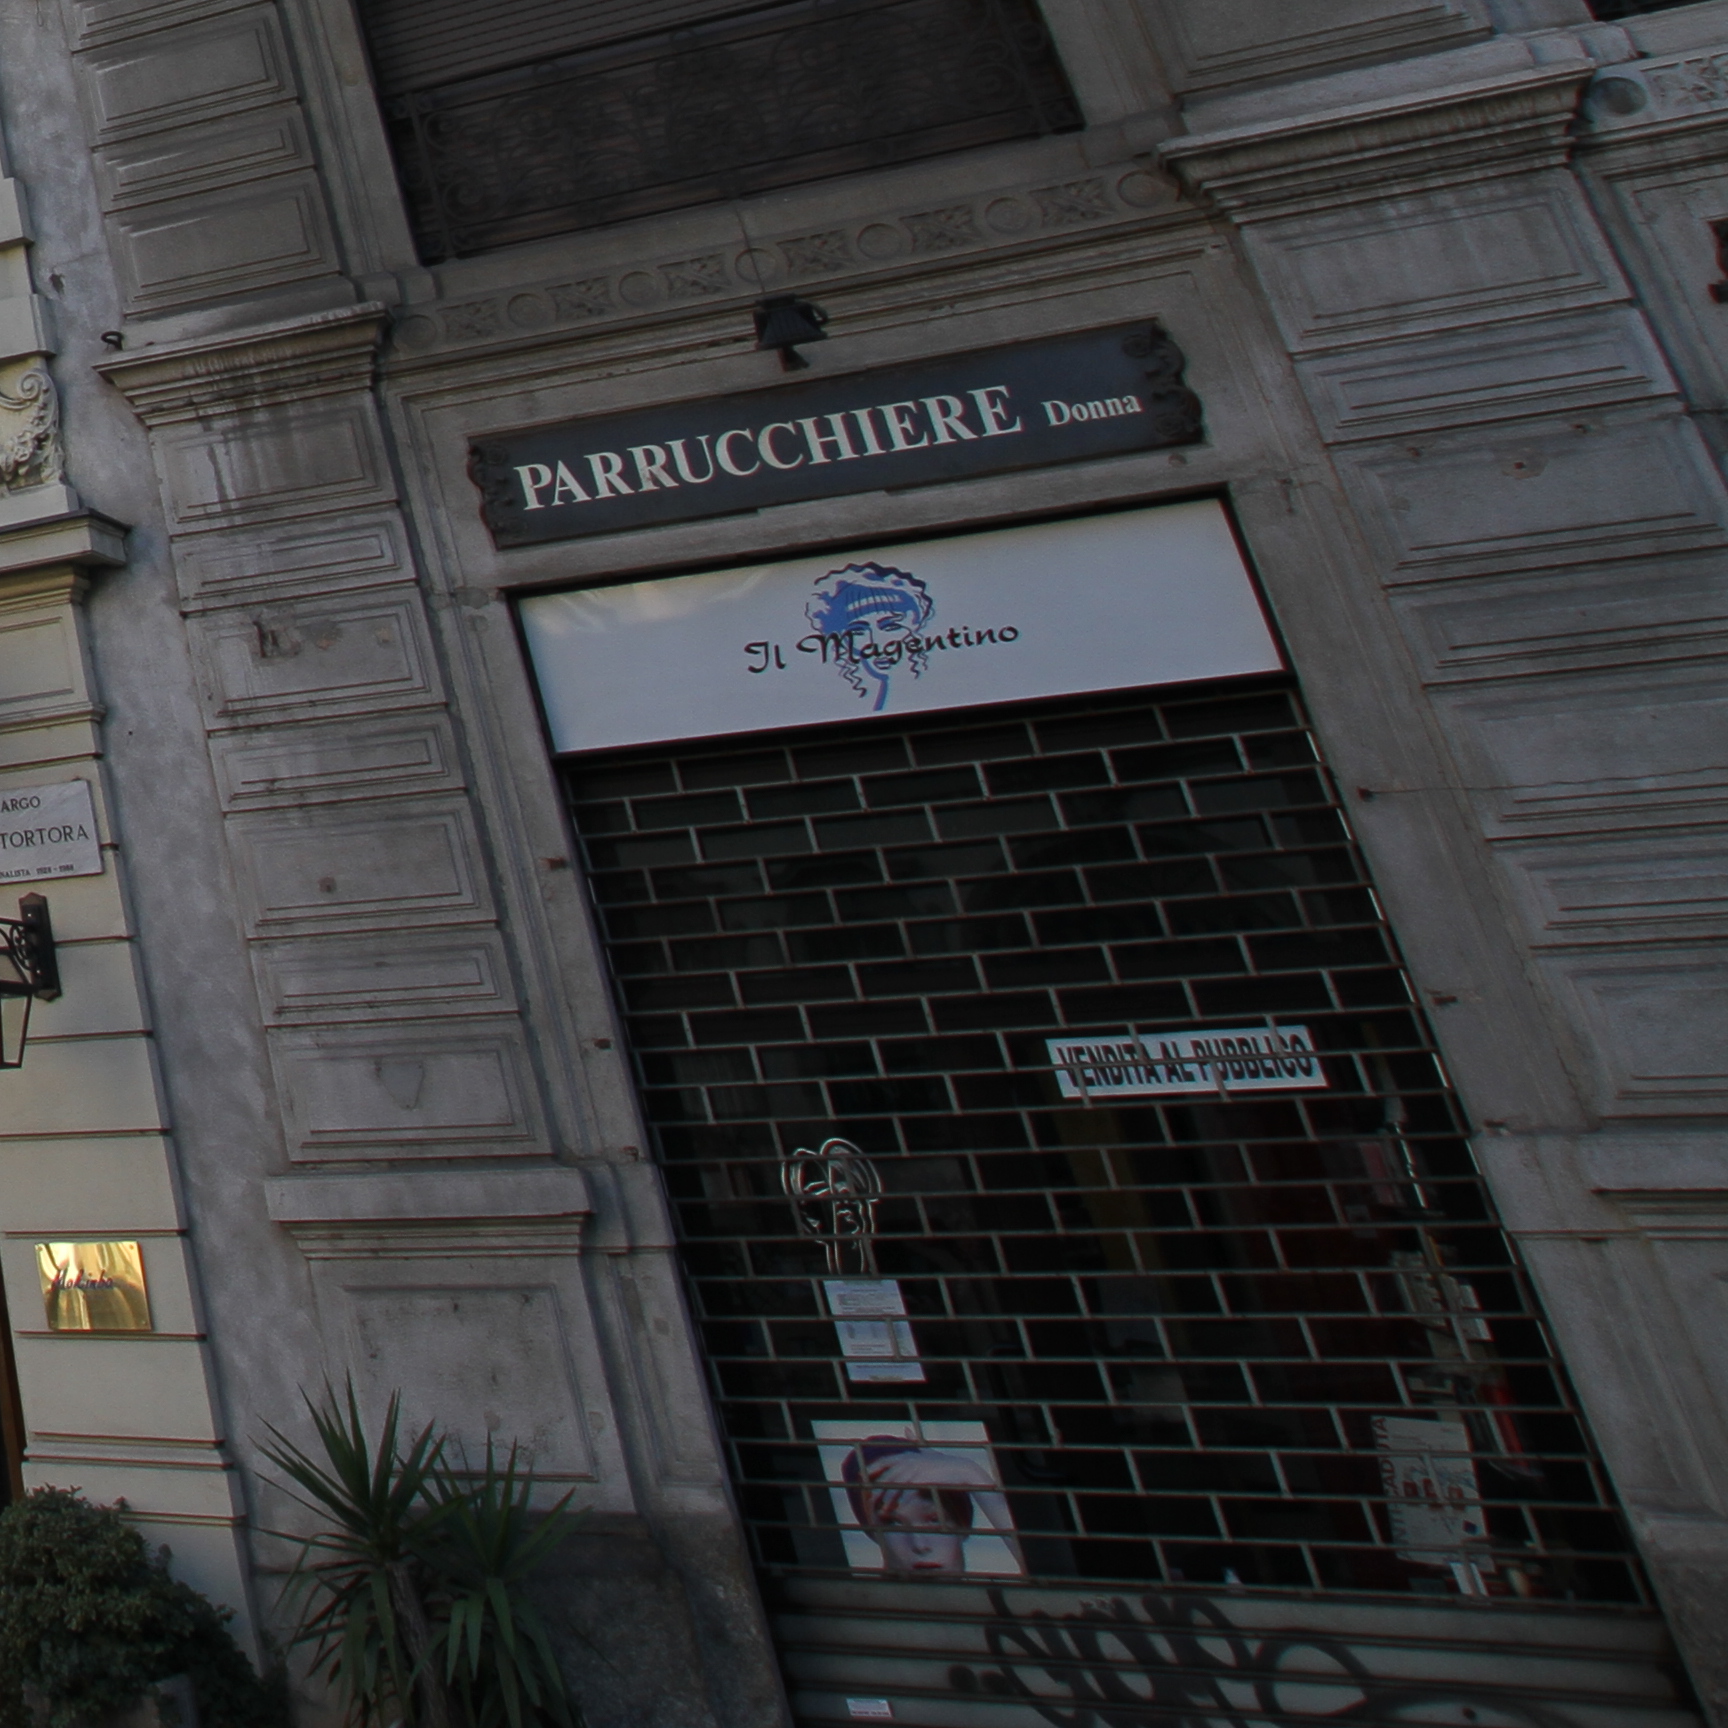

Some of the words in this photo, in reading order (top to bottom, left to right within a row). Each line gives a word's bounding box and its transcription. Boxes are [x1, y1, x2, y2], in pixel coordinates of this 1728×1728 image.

[514, 384, 1023, 511] PARRUCCHIERE
[1041, 394, 1142, 427] Donna
[744, 640, 787, 673] Il
[796, 625, 1019, 665] Magentino
